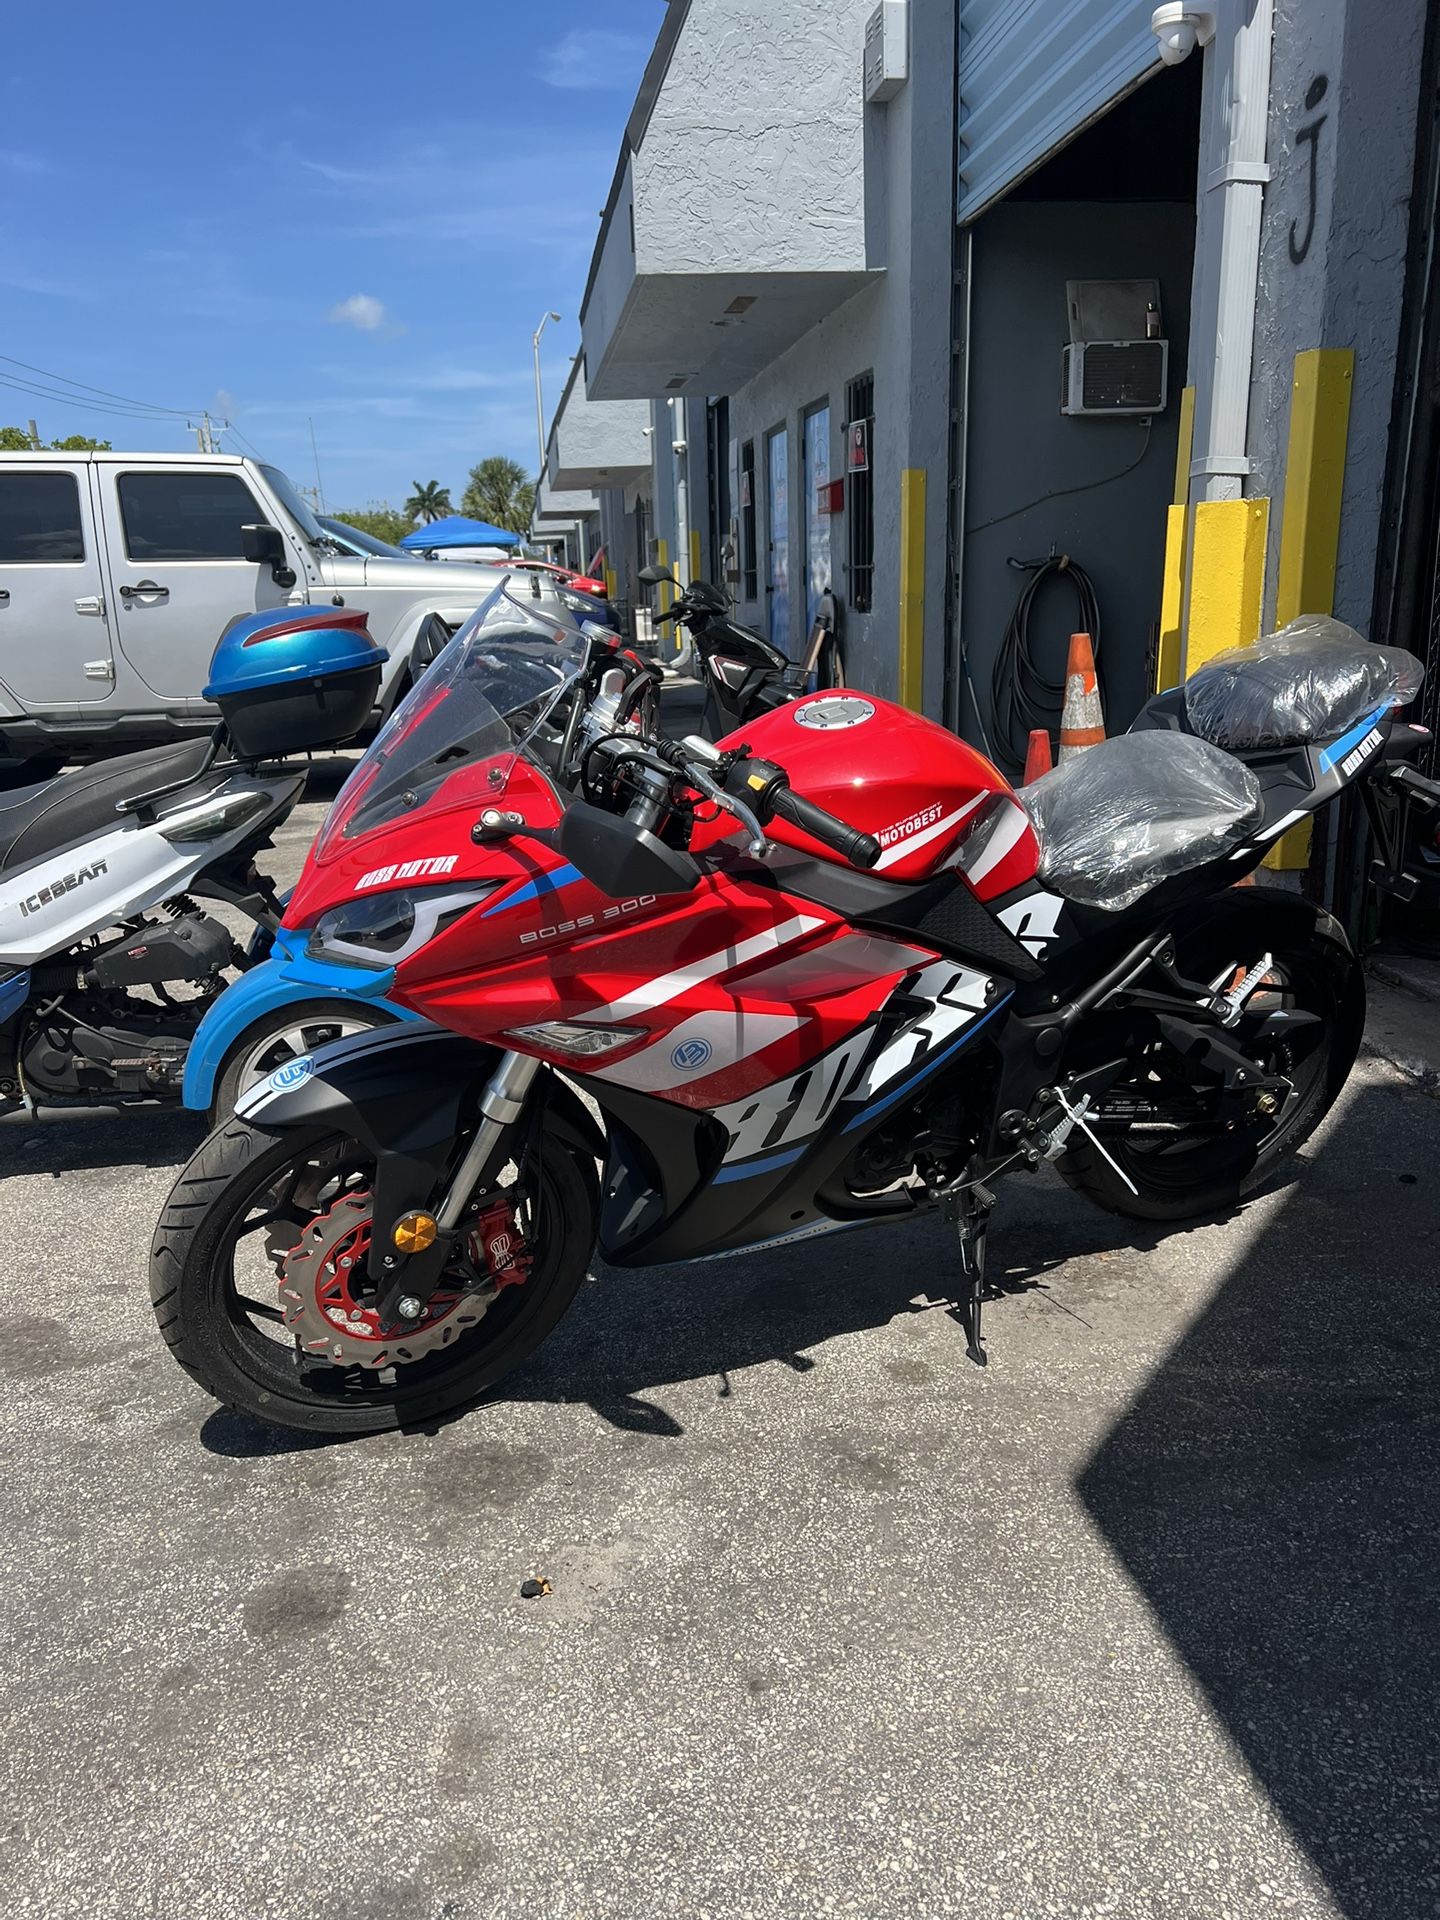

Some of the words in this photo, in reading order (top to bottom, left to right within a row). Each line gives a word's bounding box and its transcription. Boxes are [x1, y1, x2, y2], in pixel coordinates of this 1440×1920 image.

[880, 805, 943, 848] MOTOBEST
[19, 859, 108, 918] ICEBEAR
[394, 855, 460, 879] MOTOR
[519, 914, 595, 944] BOSS
[603, 895, 656, 919] 300
